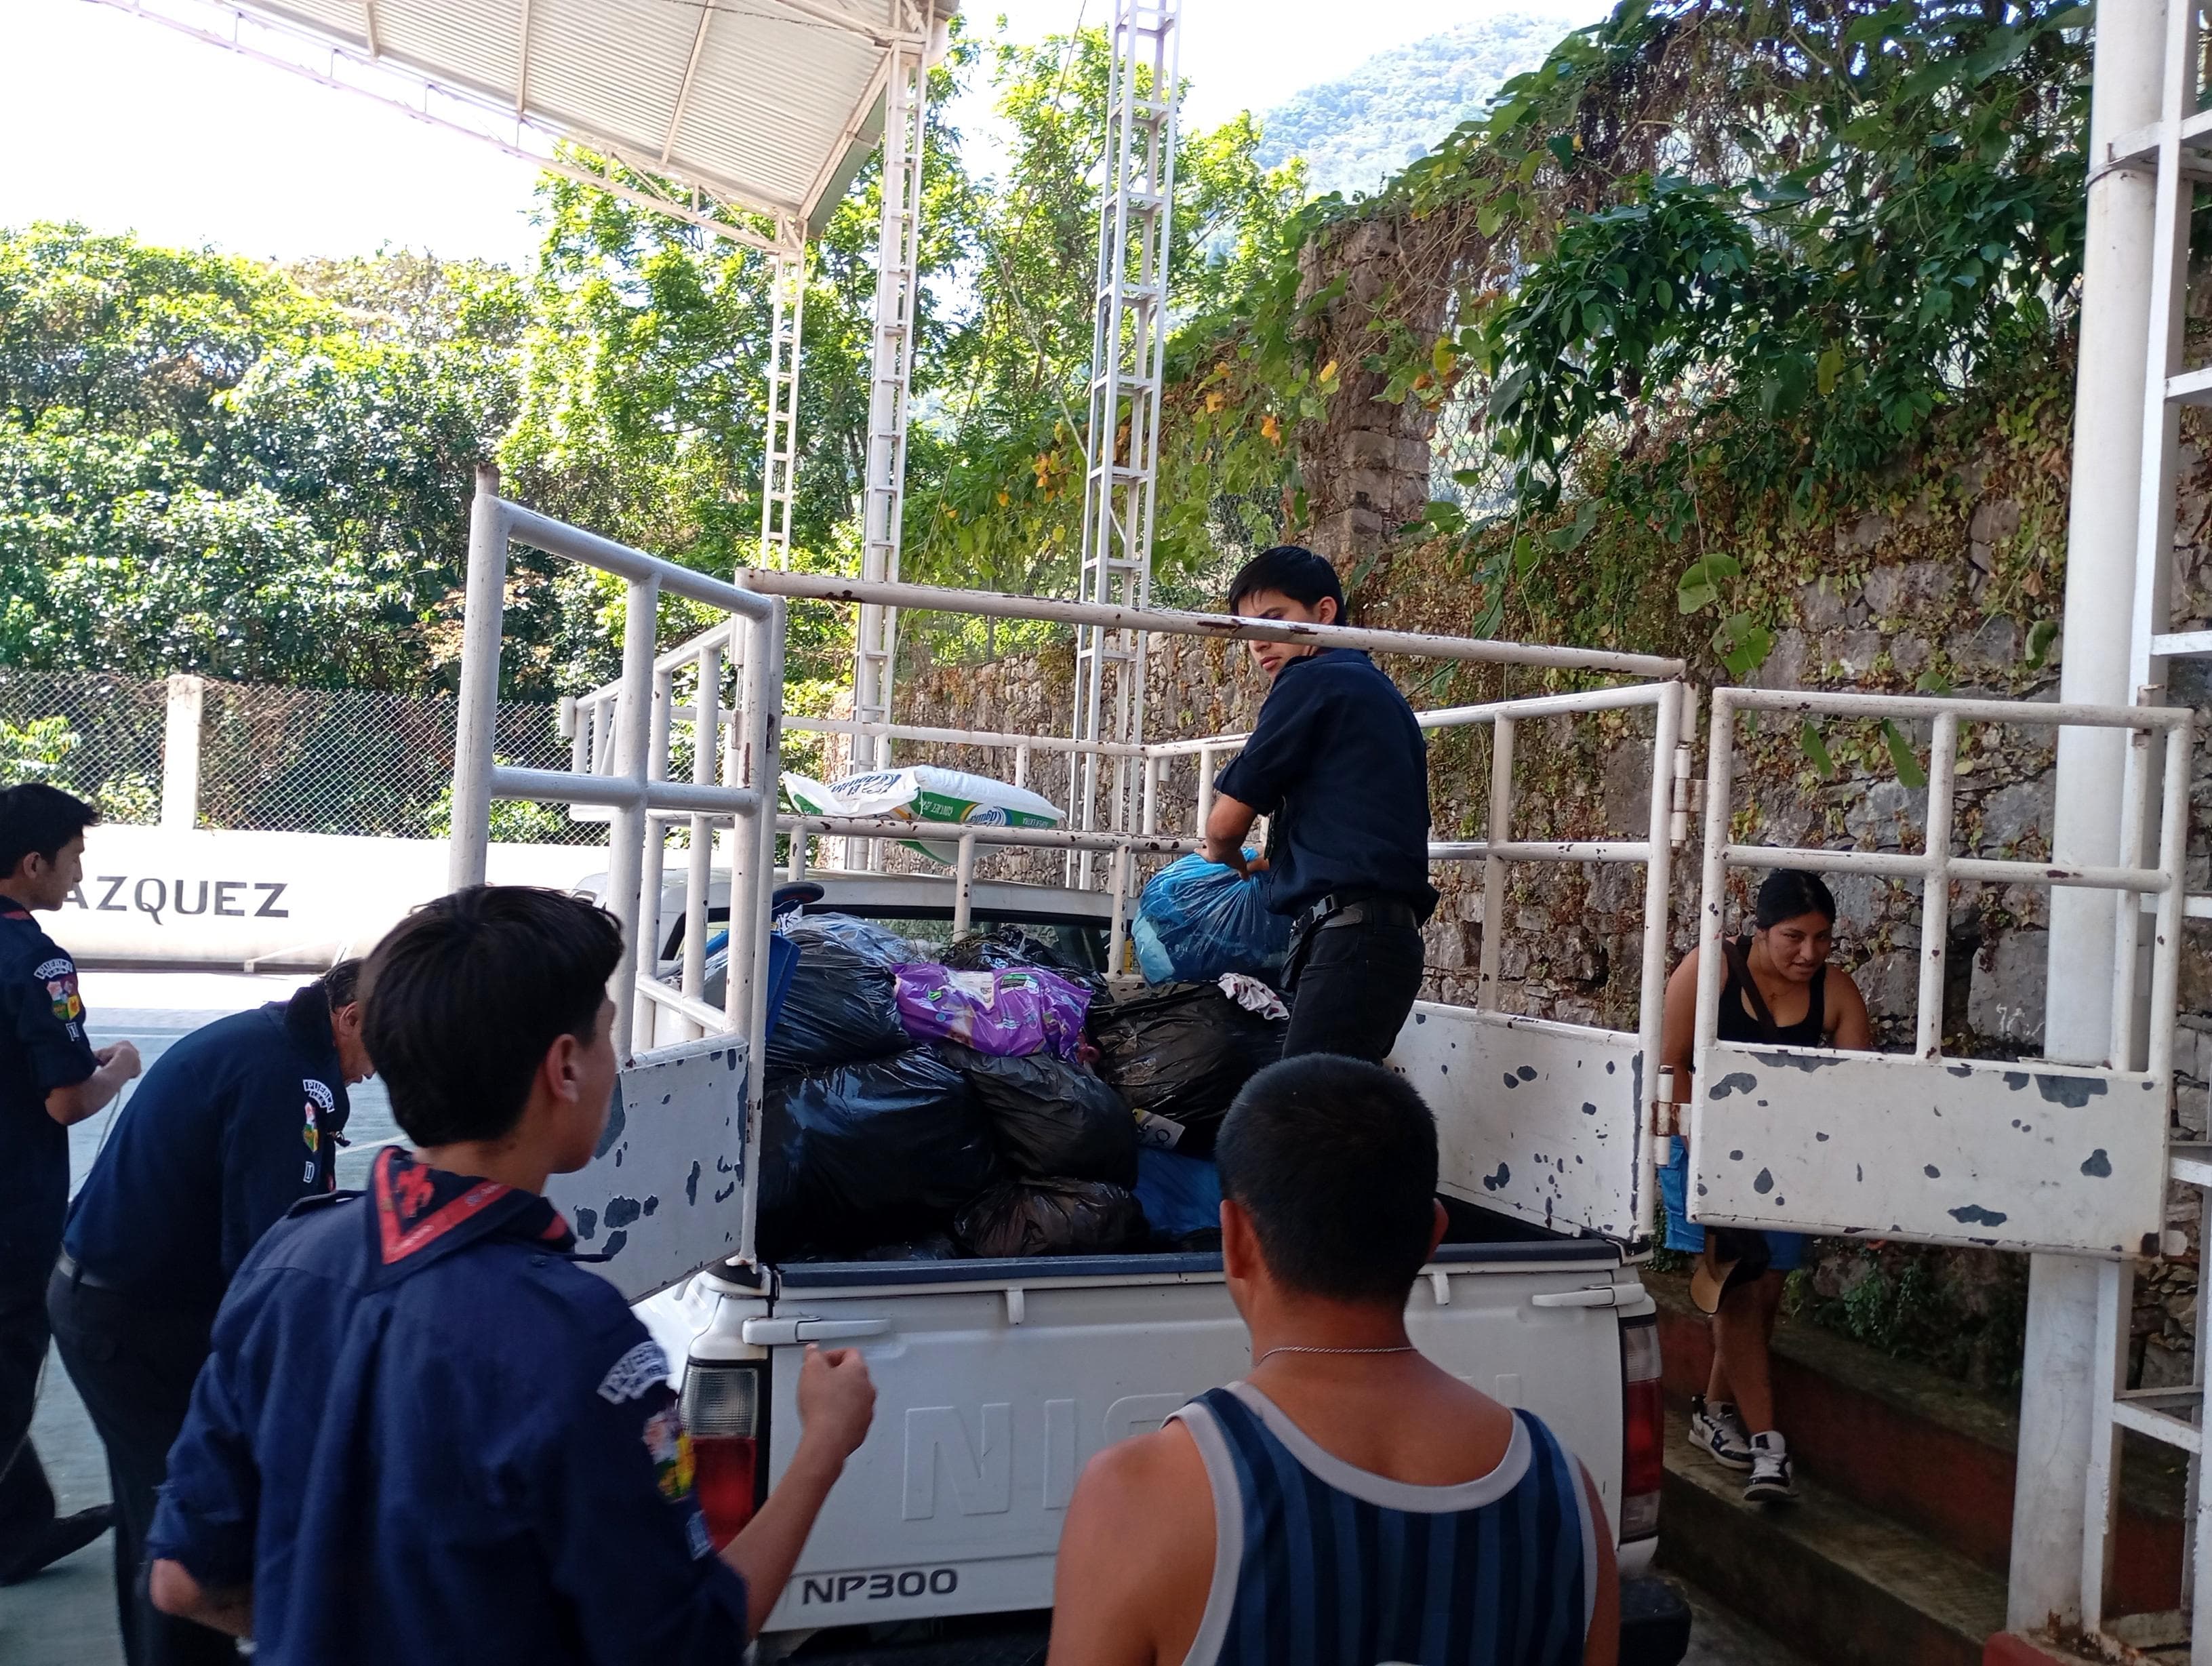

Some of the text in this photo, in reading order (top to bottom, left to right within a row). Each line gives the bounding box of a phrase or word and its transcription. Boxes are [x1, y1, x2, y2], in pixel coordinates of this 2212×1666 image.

[38, 959, 73, 976] PUEBLA
[307, 1080, 334, 1109] PUEBLA
[801, 1568, 959, 1606] NP300
